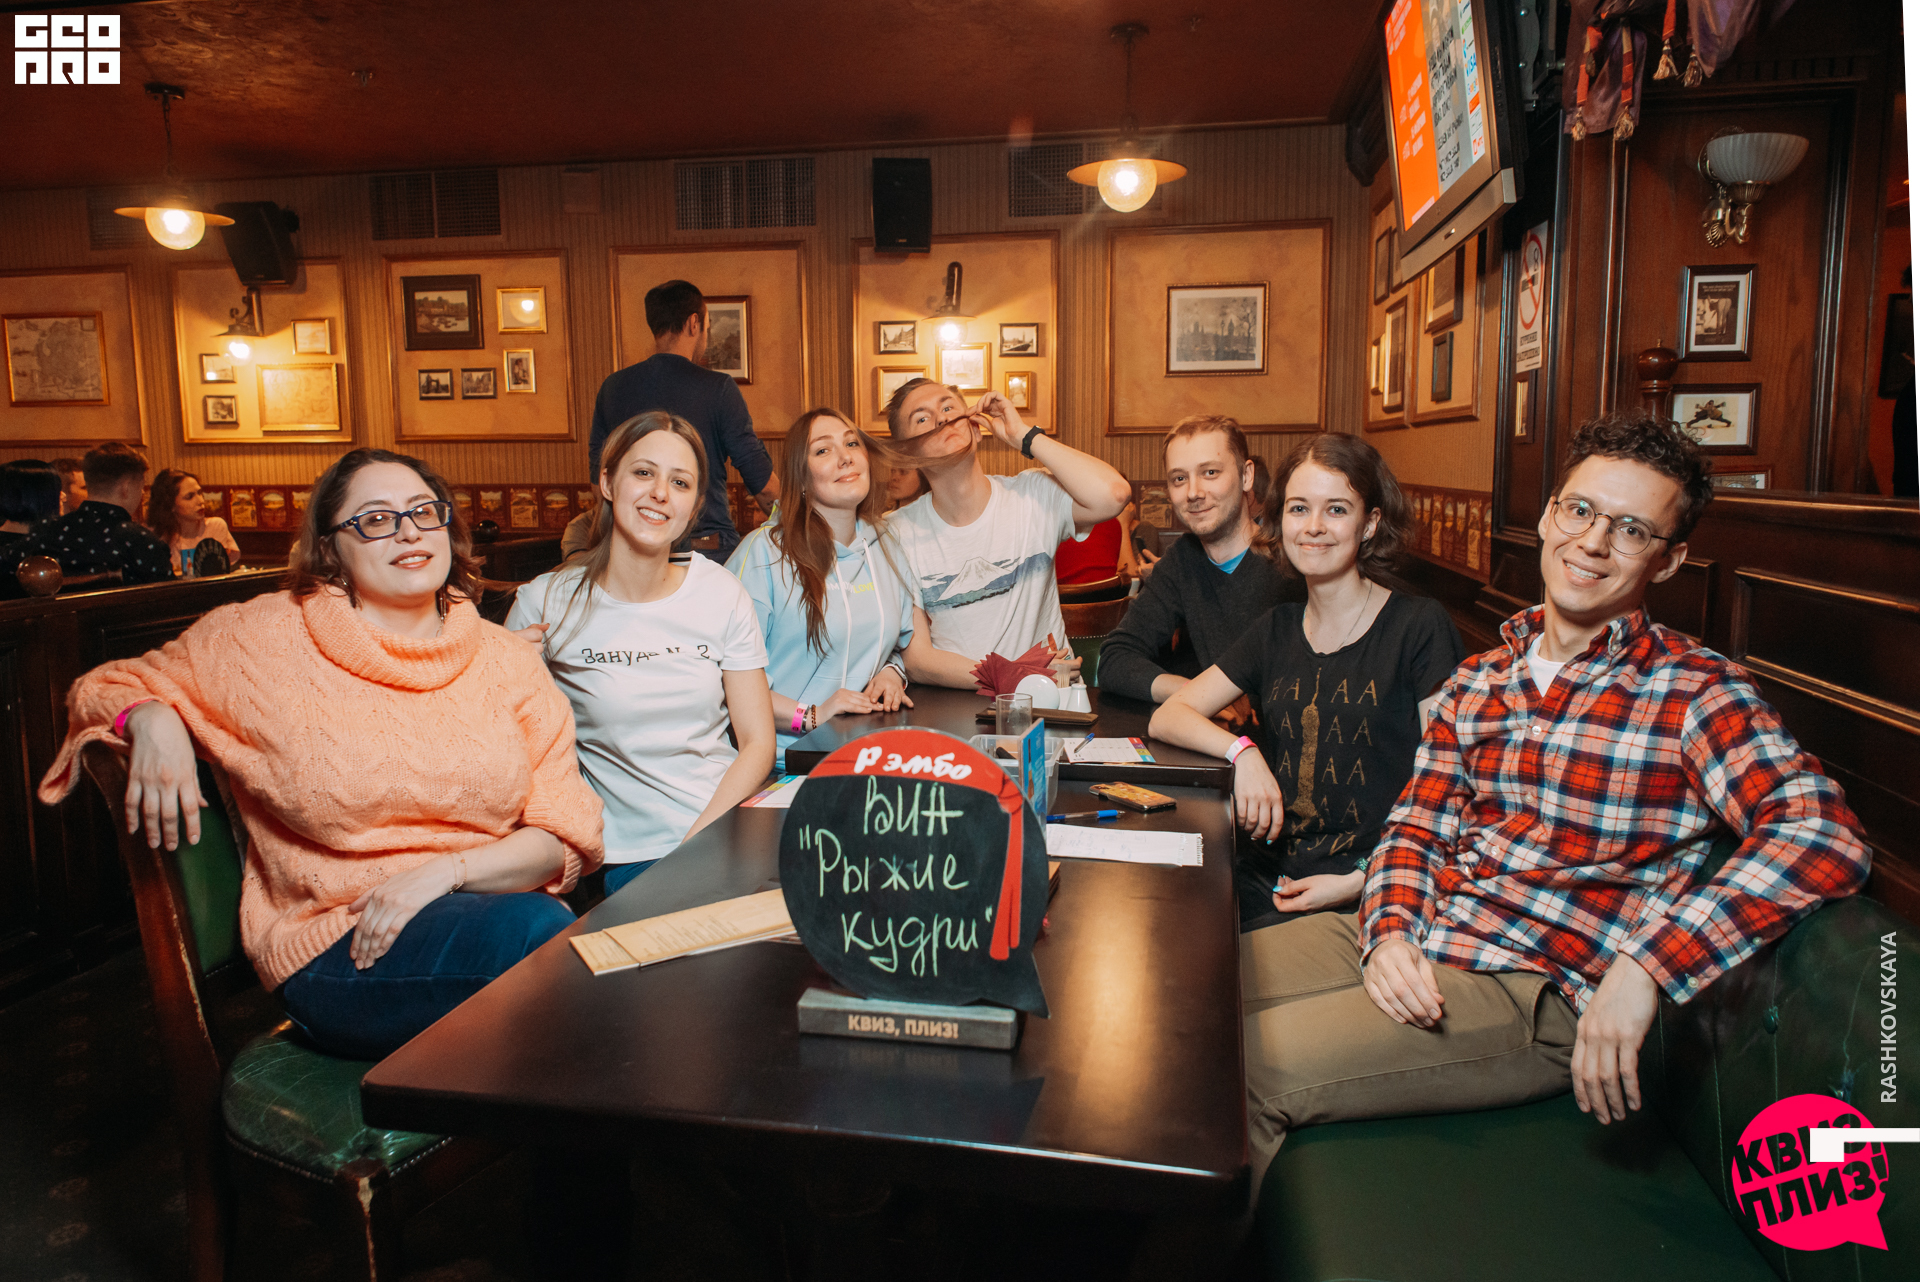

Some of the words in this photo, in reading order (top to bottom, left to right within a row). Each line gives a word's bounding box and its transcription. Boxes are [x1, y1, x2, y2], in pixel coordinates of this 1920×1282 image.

[696, 644, 711, 660] 2
[848, 1014, 901, 1037] КВИЗ,
[904, 1018, 960, 1039] ПЛИЗ!
